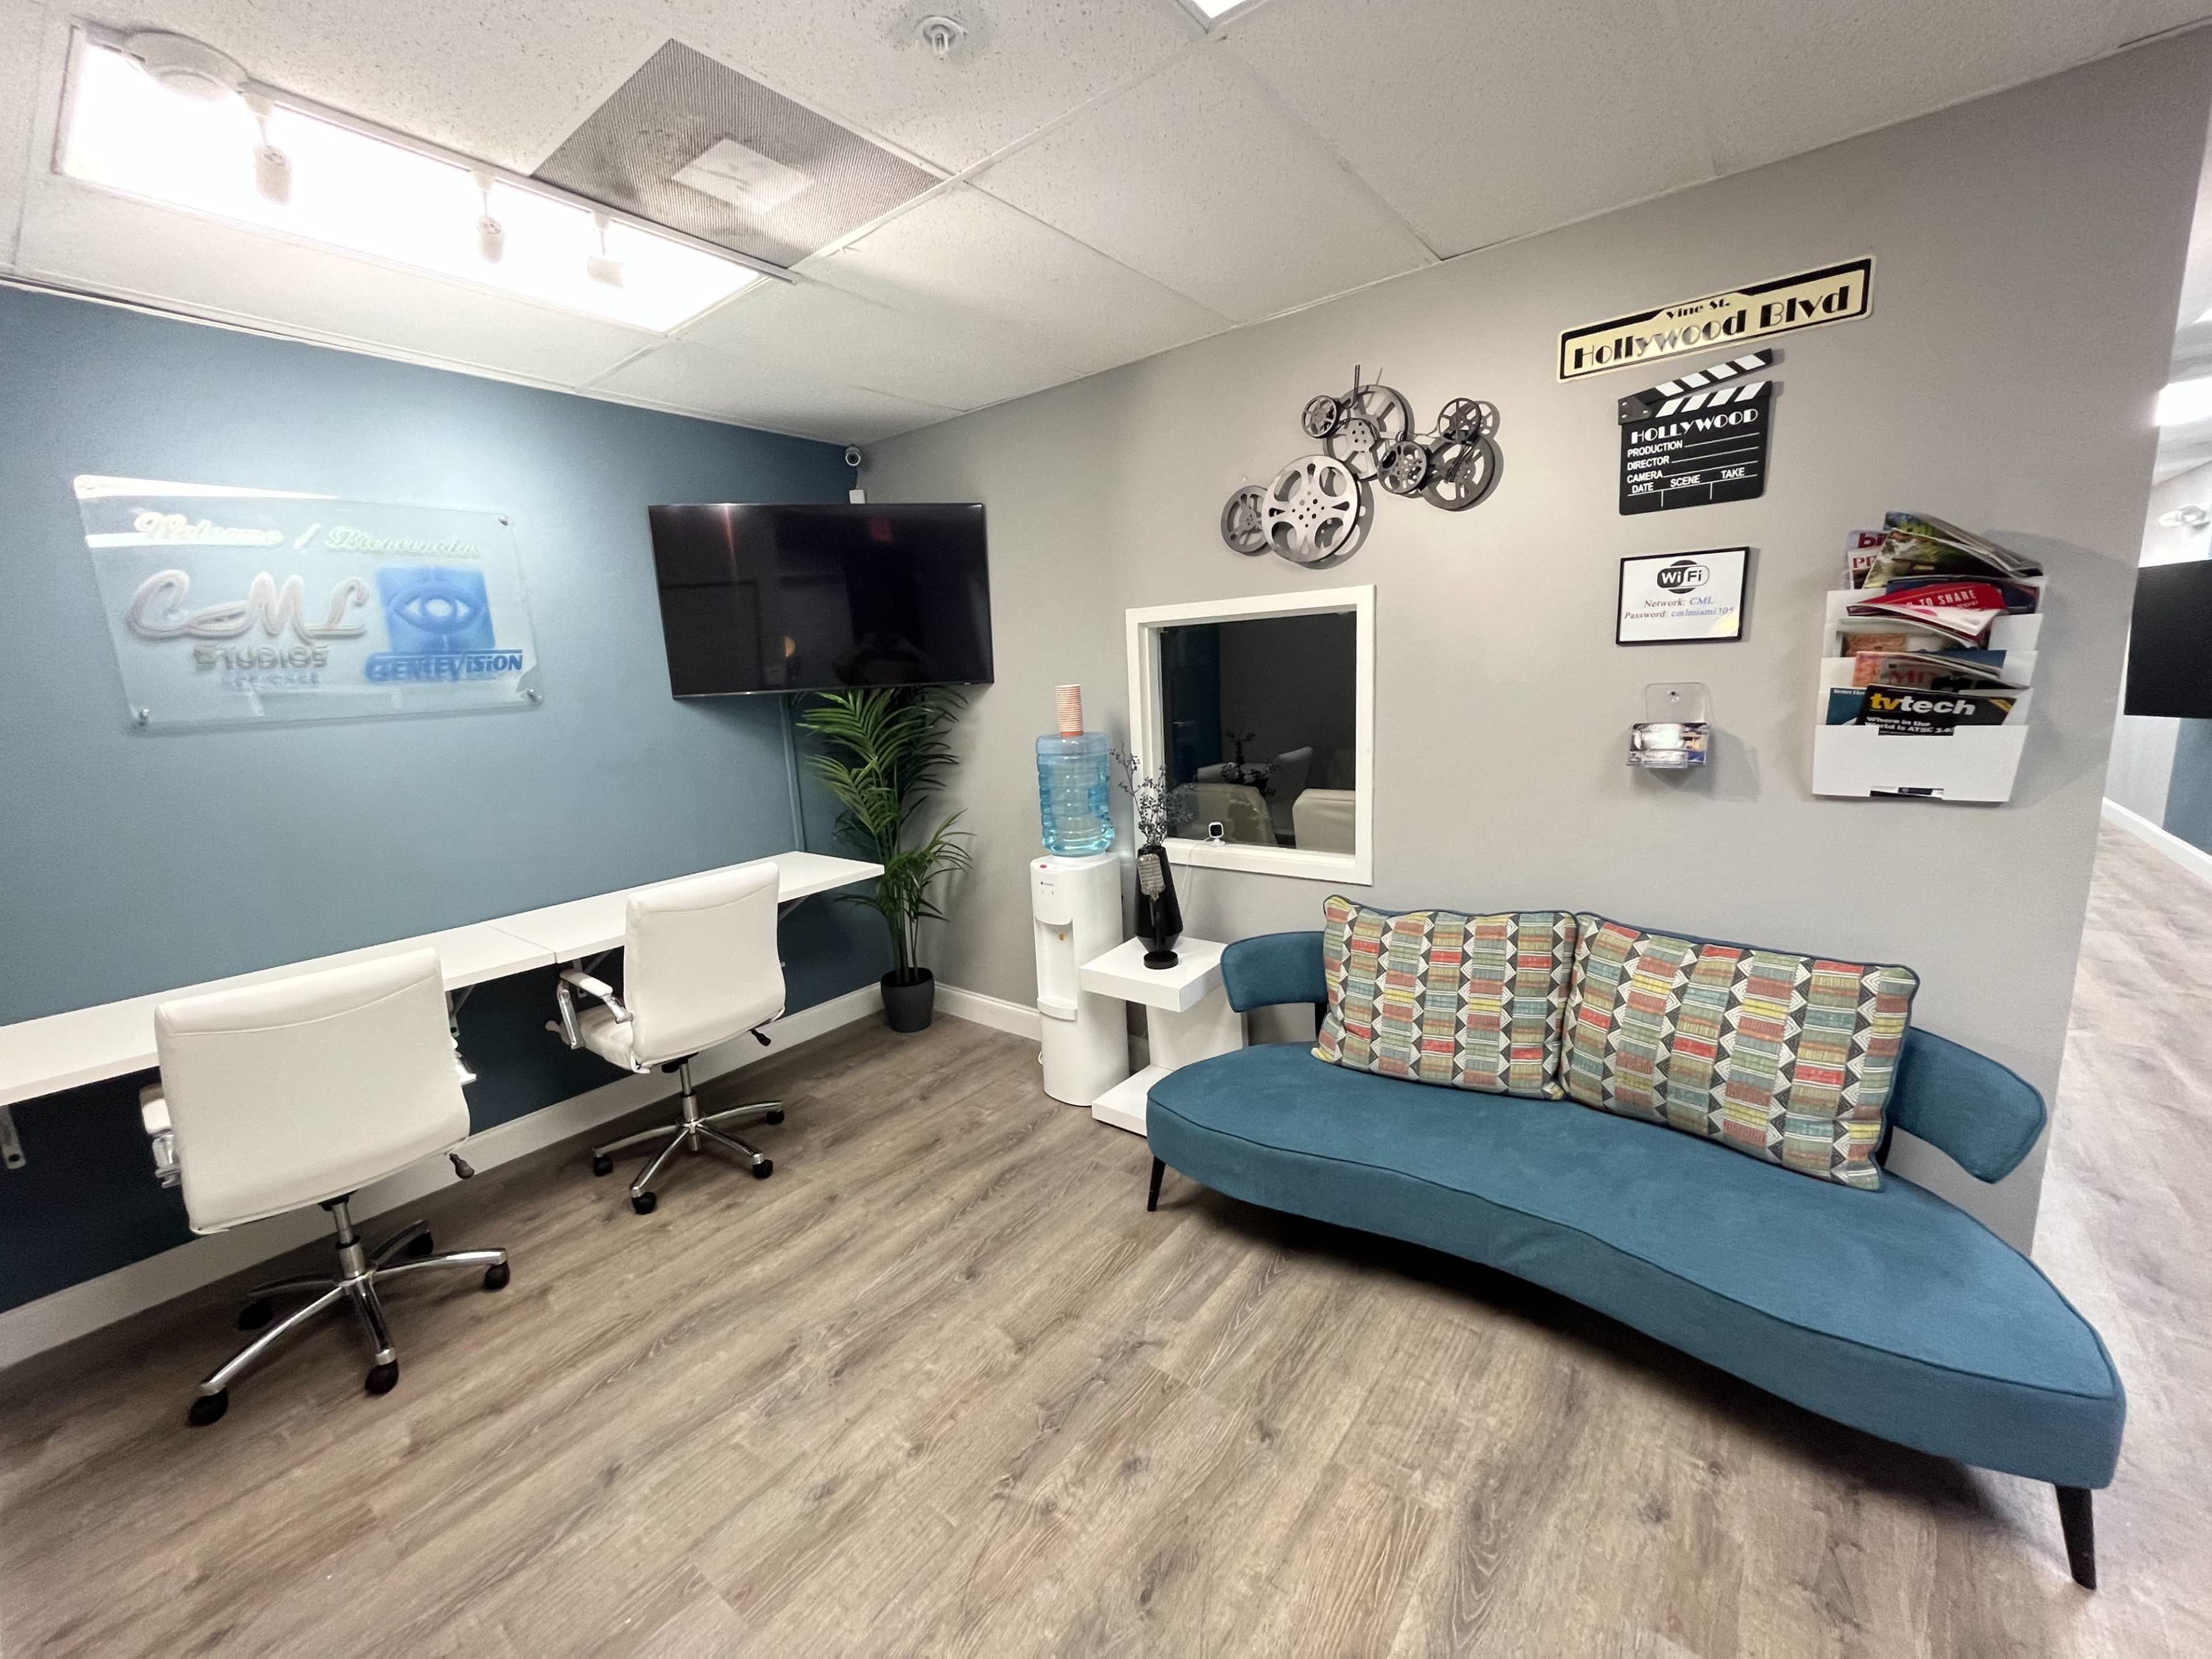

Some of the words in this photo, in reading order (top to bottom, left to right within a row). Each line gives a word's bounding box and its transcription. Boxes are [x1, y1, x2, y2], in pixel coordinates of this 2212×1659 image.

[1666, 305, 1703, 320] Vine
[1709, 298, 1730, 309] St.
[1574, 310, 1746, 369] Hollywood
[1760, 286, 1850, 328] Blvd
[1631, 408, 1758, 444] HOLLYWOOD
[1627, 440, 1683, 458] PRODUCTION
[1627, 456, 1669, 471] DIRECTOR
[1627, 470, 1663, 484] CAMERA
[1632, 482, 1654, 494] DATE
[1671, 475, 1700, 488] SCENE
[1721, 467, 1745, 479] TAKE
[1644, 598, 1685, 608] Network:
[1690, 596, 1714, 605] CML
[1938, 590, 1976, 605] SHARE
[1625, 611, 1667, 619] Password:
[194, 642, 328, 672] STUDIOS
[1870, 693, 1976, 715] tvtech
[1866, 717, 1900, 725] Where
